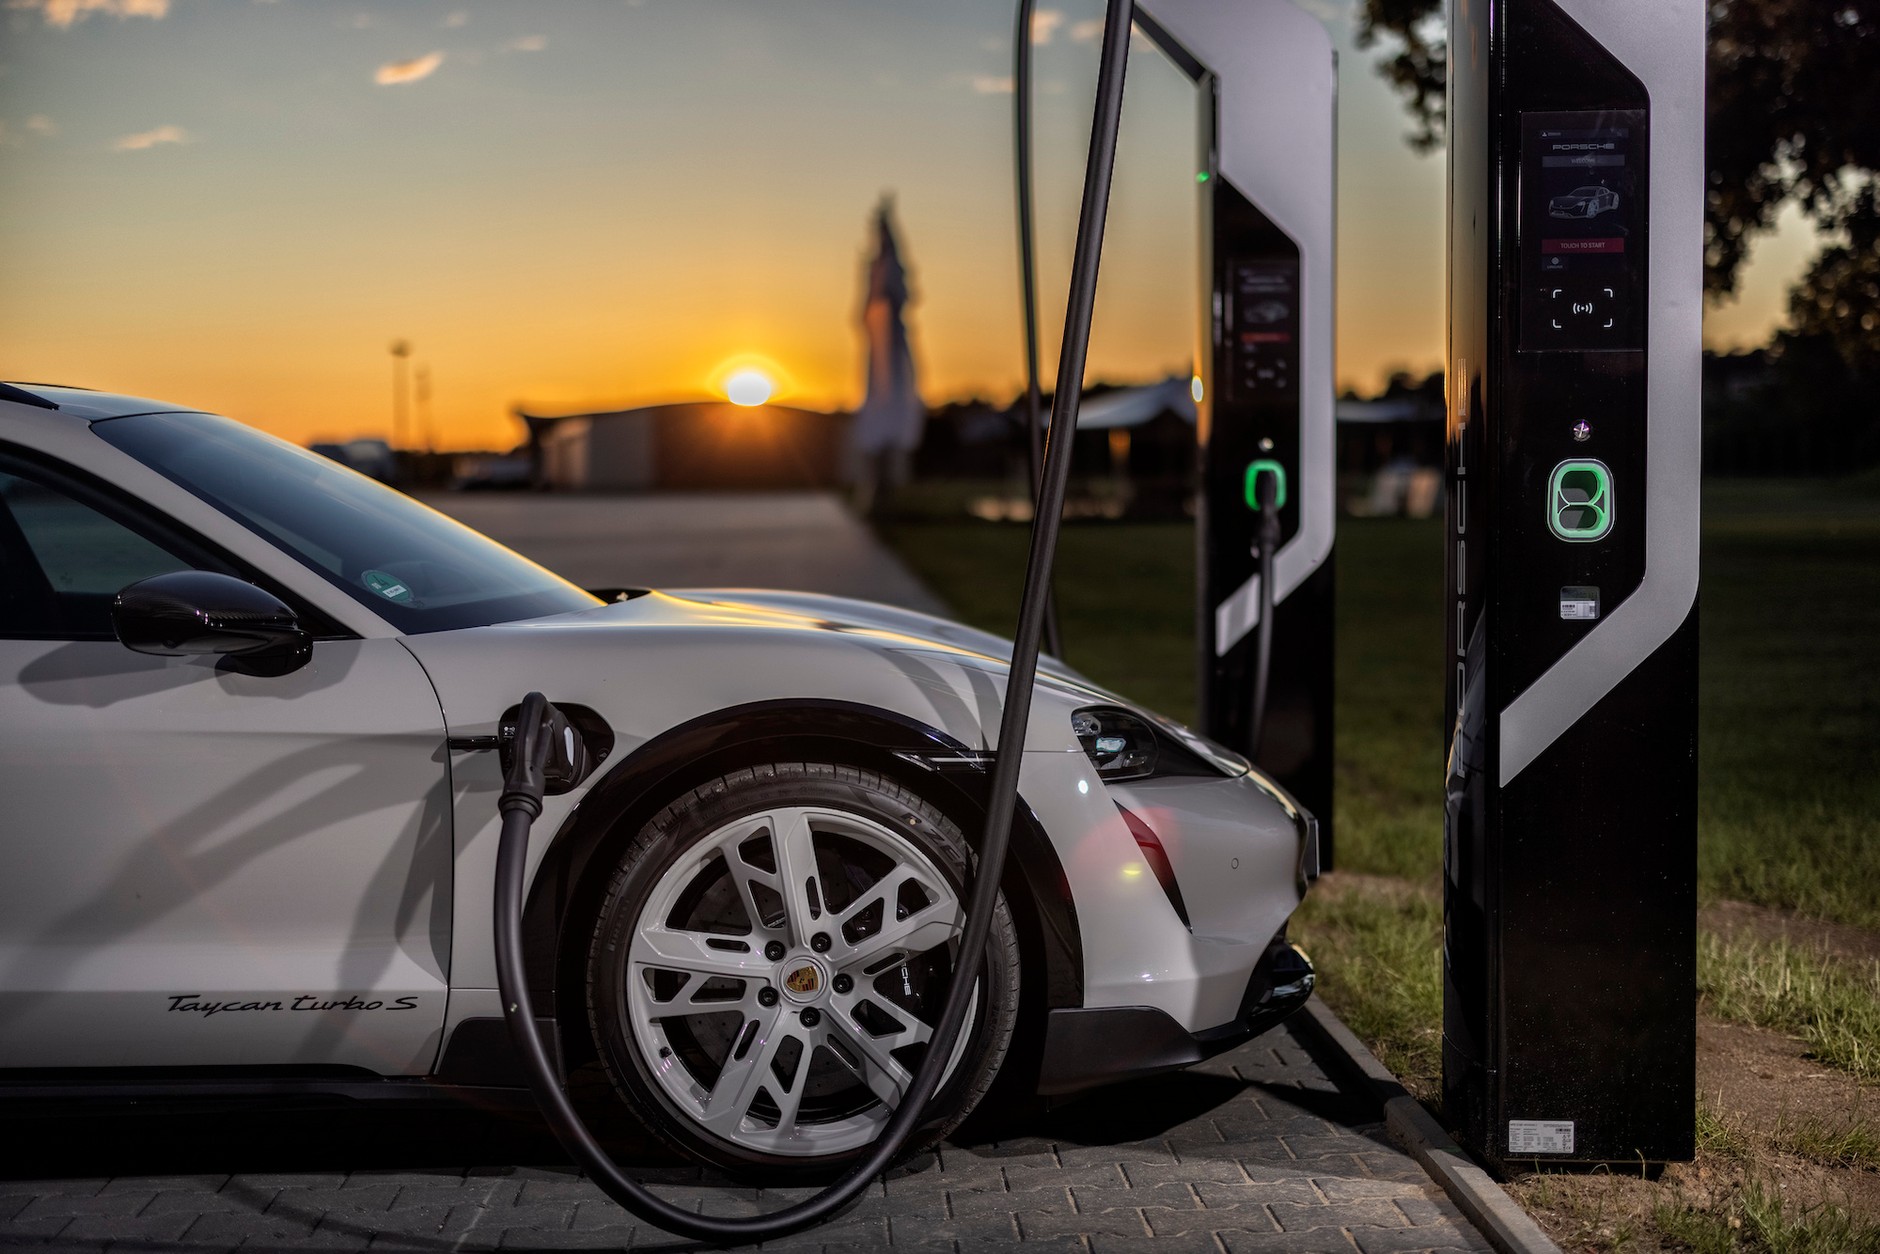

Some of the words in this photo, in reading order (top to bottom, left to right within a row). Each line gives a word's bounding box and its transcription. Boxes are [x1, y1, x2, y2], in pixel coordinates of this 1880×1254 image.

[1456, 358, 1467, 779] PORSCHE
[168, 994, 283, 1018] Taycan
[290, 995, 384, 1011] turbo
[385, 996, 418, 1011] S
